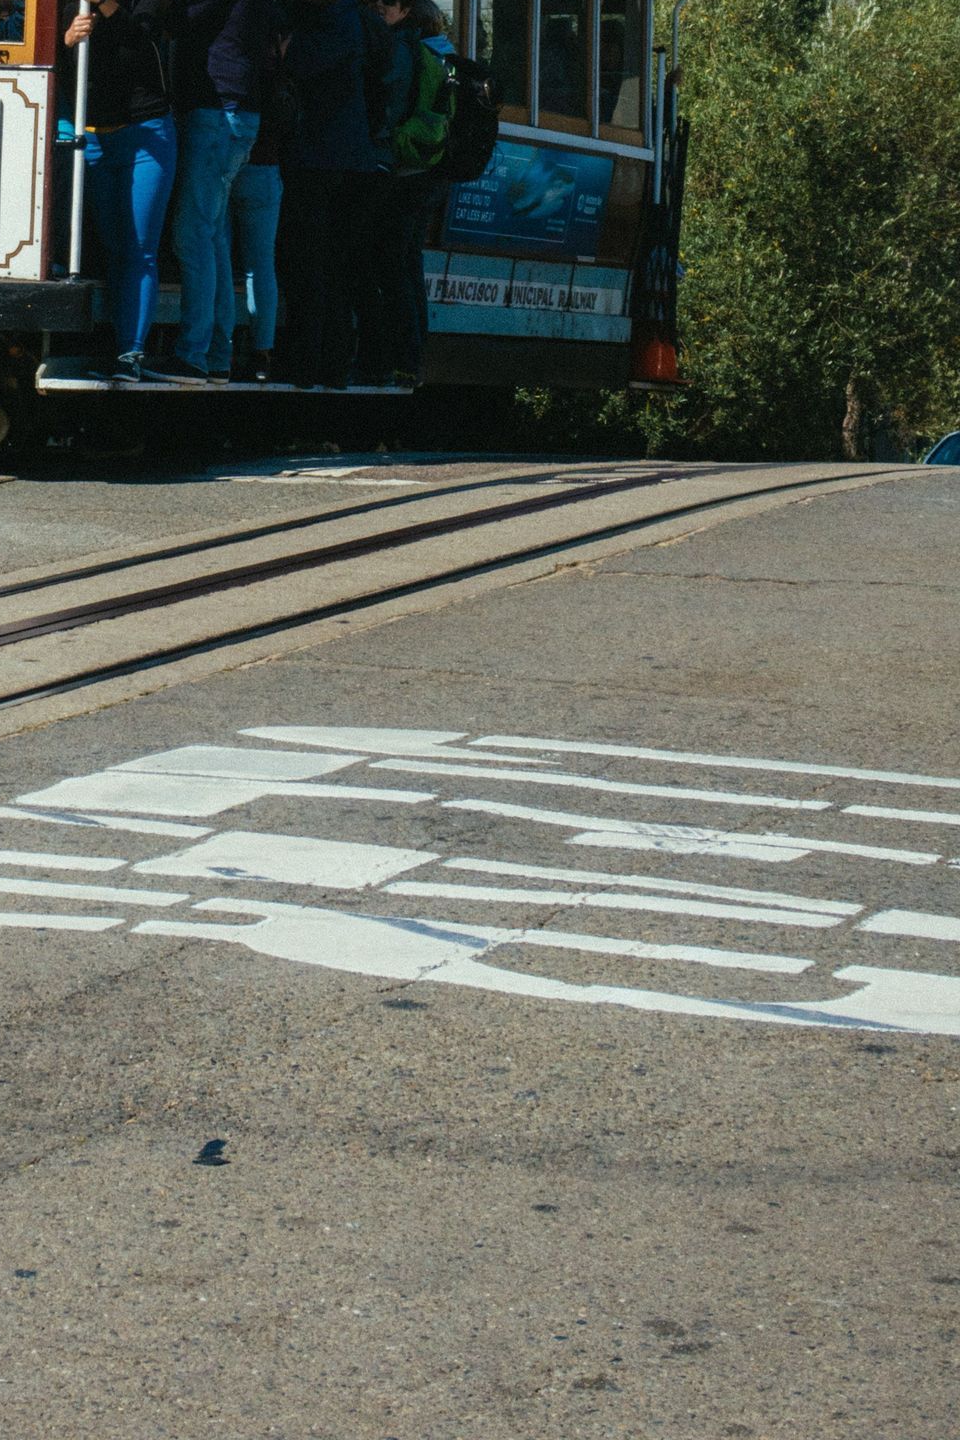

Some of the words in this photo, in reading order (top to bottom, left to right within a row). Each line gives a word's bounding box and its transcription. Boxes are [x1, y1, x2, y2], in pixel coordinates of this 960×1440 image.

[434, 279, 497, 303] FRANCISCO
[503, 285, 554, 306] MUNICIPAL
[557, 289, 597, 310] RAILWAY
